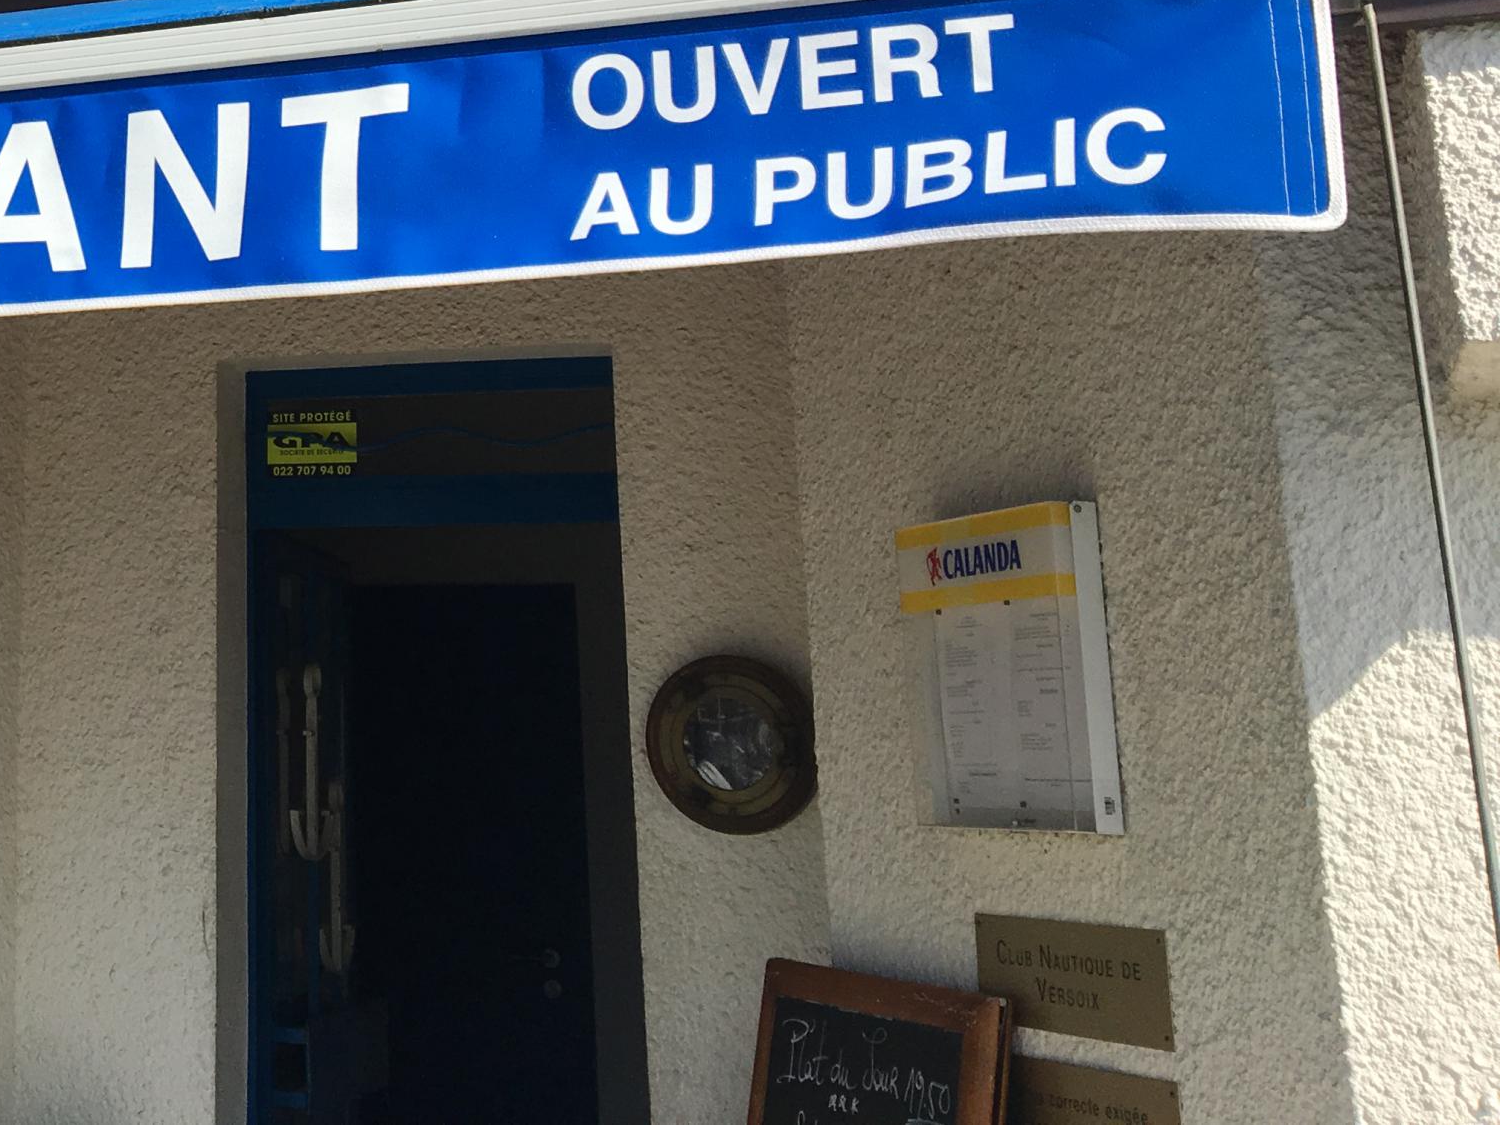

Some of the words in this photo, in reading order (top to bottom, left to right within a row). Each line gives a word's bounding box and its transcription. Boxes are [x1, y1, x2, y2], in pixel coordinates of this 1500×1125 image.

[571, 14, 1014, 130] OUVERT
[570, 164, 713, 241] AU
[754, 107, 1167, 227] PUBLIC
[272, 413, 295, 423] SITE
[273, 431, 350, 448] GPA
[273, 466, 293, 476] 022
[297, 466, 316, 475] 707
[320, 465, 334, 475] 94
[337, 465, 351, 475] 00
[943, 539, 1021, 580] CALANDA
[996, 940, 1032, 967] CLUB
[1038, 944, 1113, 977] NAUTIQUE
[1121, 962, 1142, 981] DE
[1036, 976, 1100, 1010] VERSOIX
[830, 1047, 858, 1090] du
[1049, 1094, 1100, 1117] correcte
[1105, 1105, 1148, 1125] exigée
